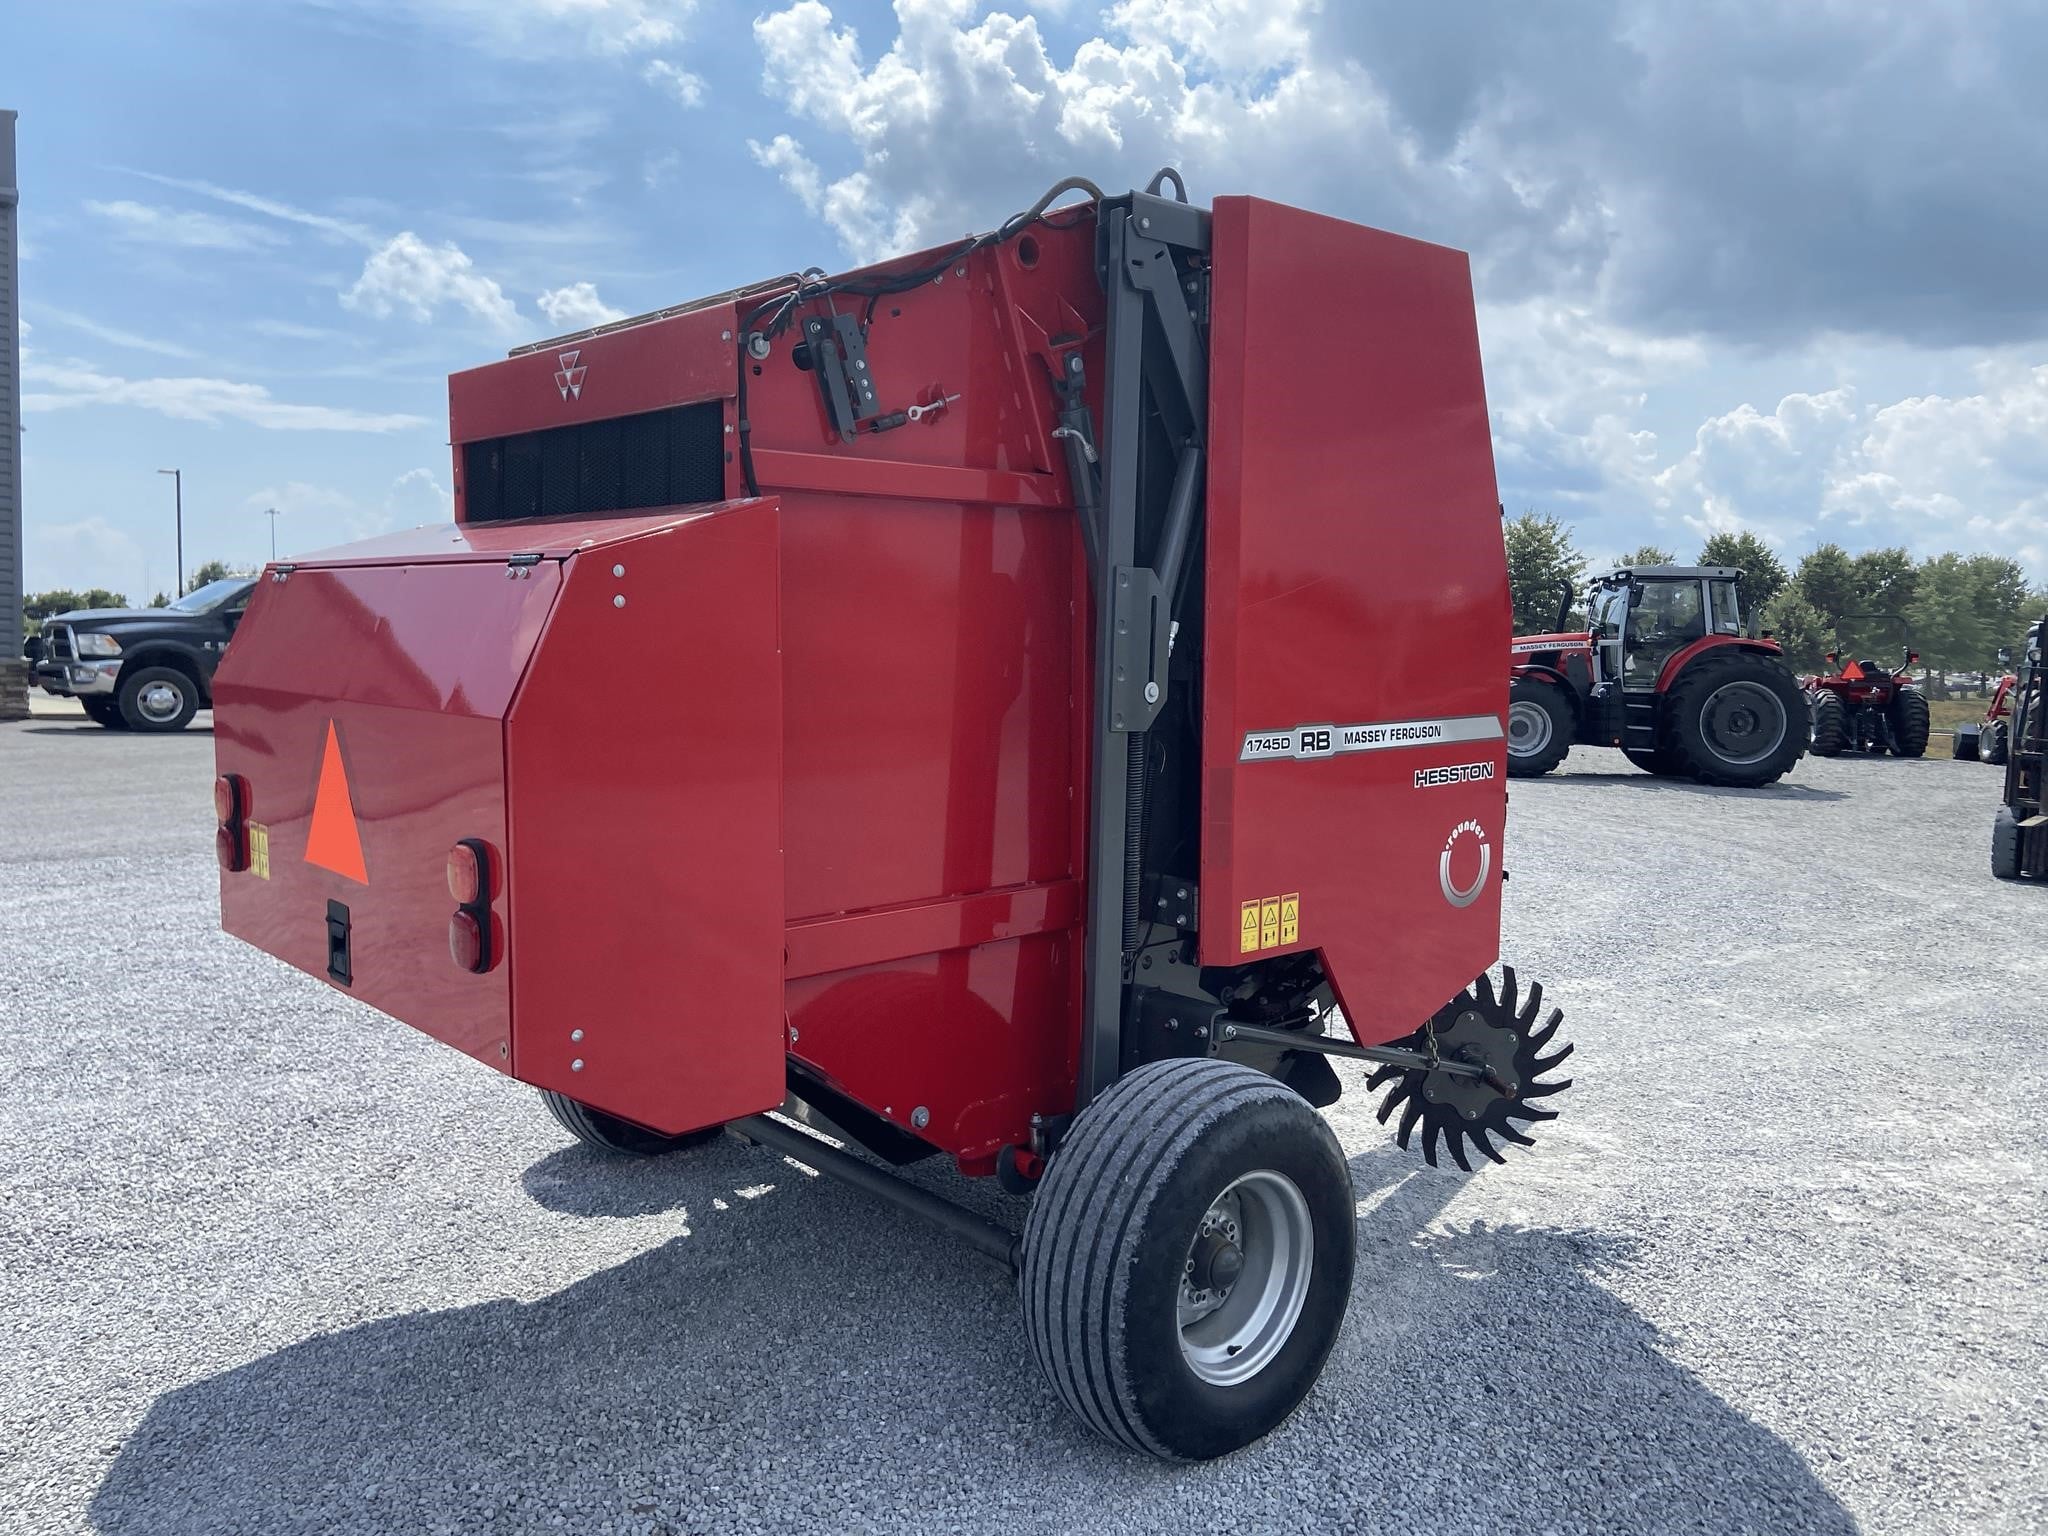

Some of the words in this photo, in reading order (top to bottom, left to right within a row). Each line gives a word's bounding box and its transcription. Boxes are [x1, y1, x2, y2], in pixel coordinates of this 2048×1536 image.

[1246, 737, 1291, 752] 1745D
[1301, 730, 1331, 752] RB
[1344, 729, 1387, 745] MASSEY
[1390, 725, 1442, 741] FERGUSON
[1414, 761, 1494, 788] HESSTON
